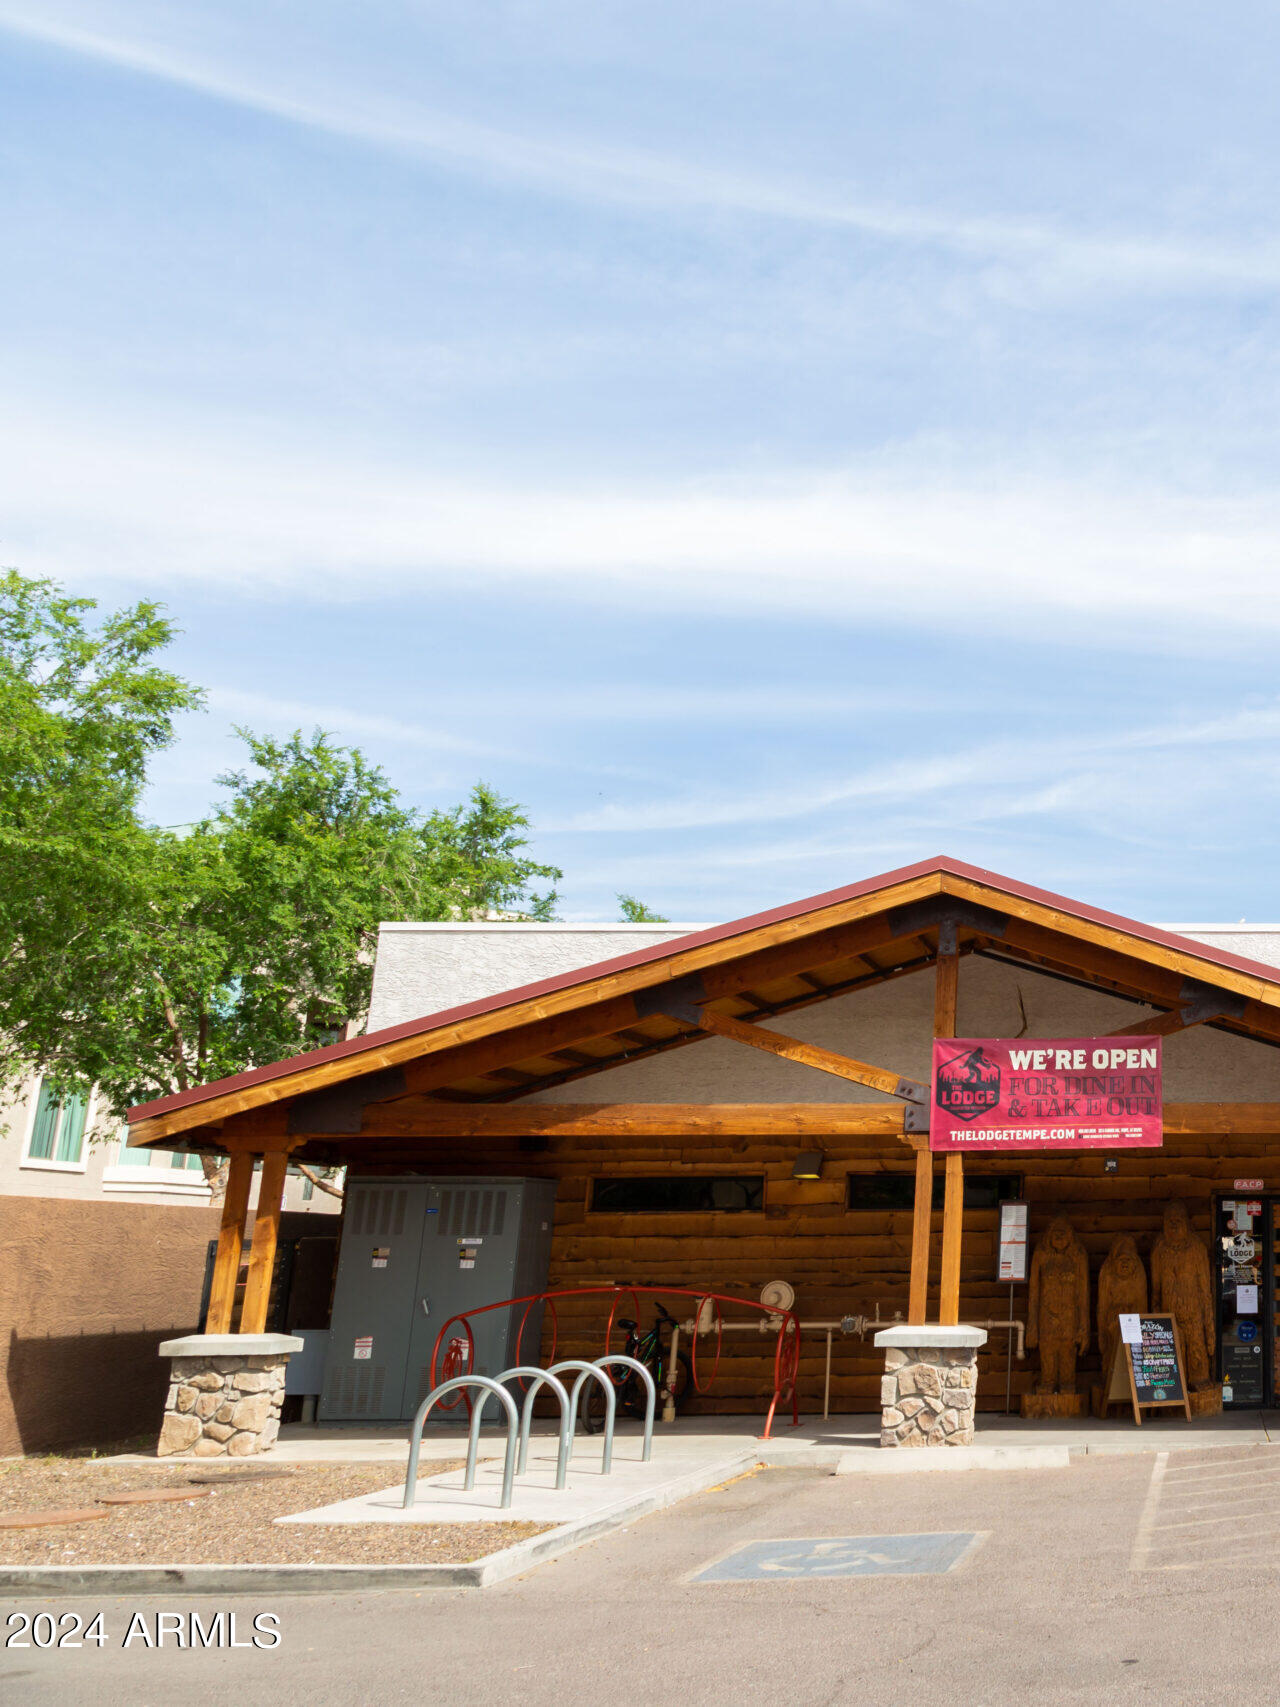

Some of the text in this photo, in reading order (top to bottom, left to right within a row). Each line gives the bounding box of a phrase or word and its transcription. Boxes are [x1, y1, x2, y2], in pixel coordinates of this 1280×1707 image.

[1009, 1048, 1158, 1070] WE'RE OPEN
[1008, 1075, 1156, 1096] FOR DINE IN
[942, 1090, 995, 1105] LODGE
[1008, 1096, 1157, 1118] & TAKE OUT
[950, 1128, 1075, 1141] THELODGETEMPE.COM
